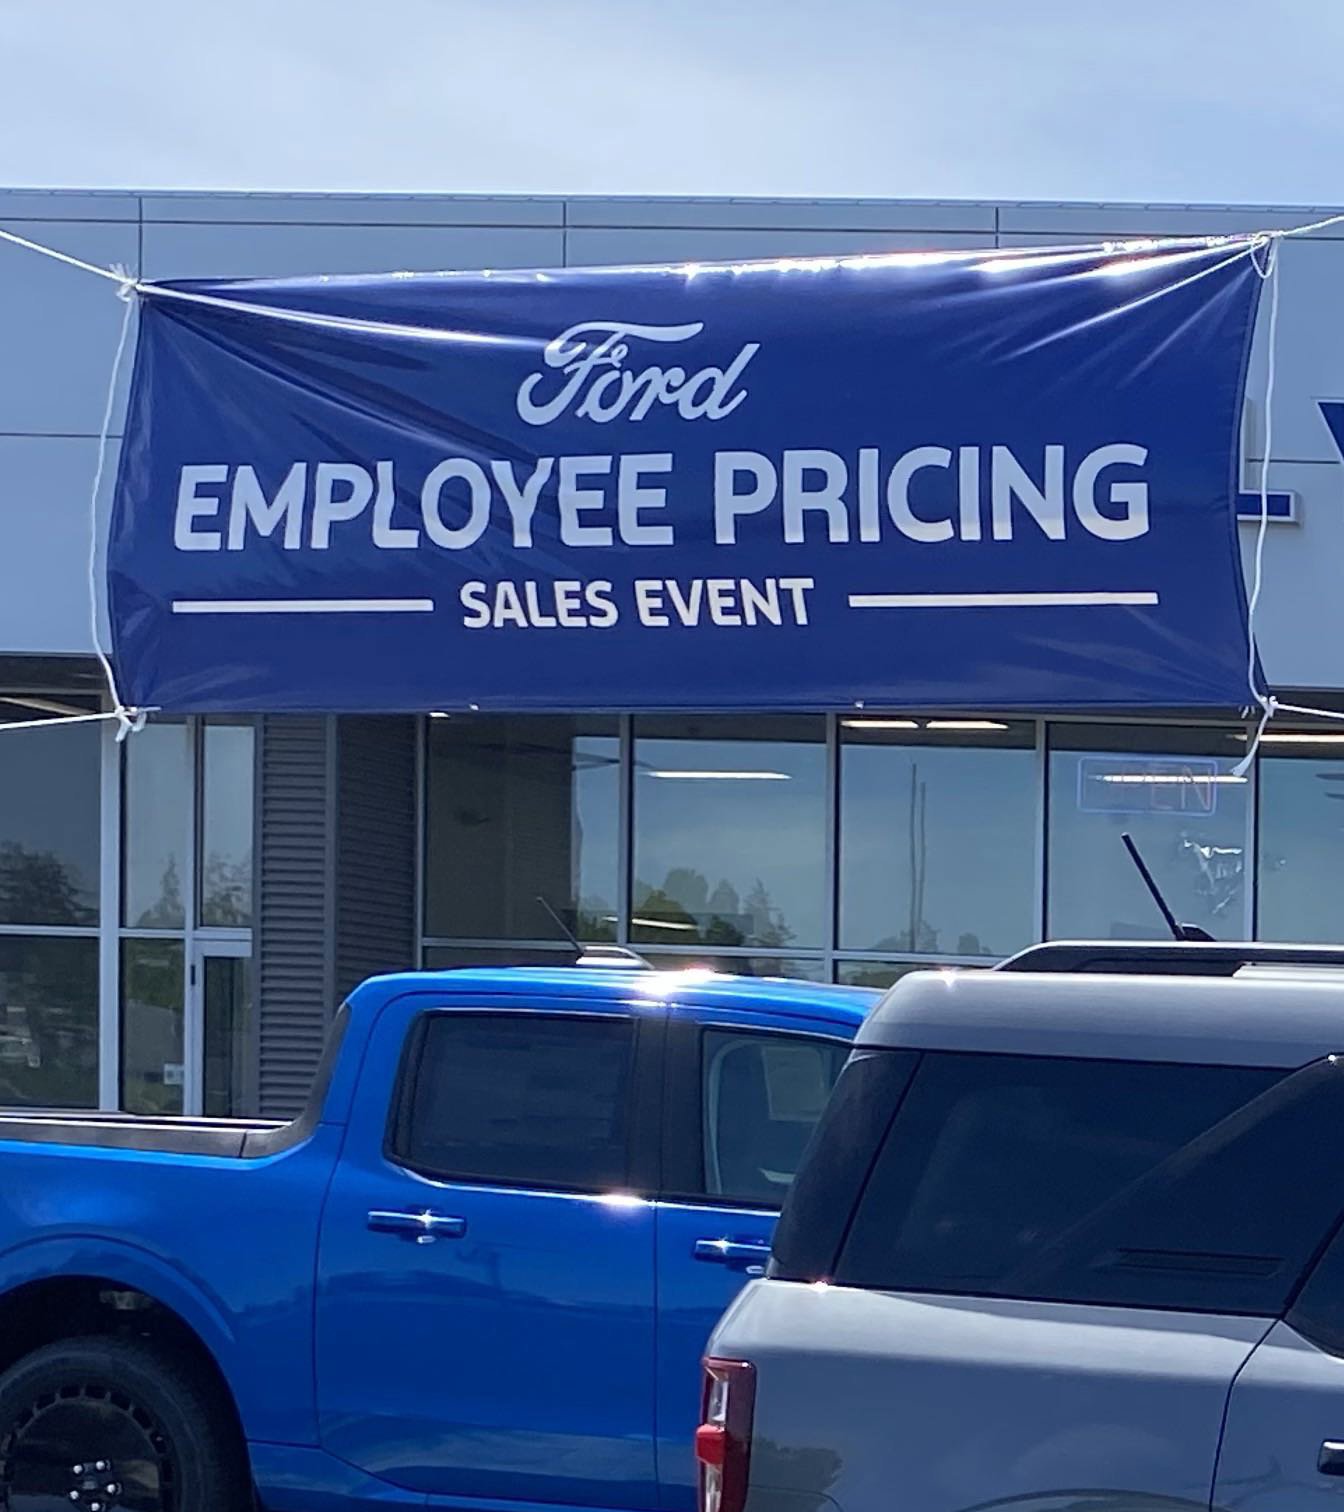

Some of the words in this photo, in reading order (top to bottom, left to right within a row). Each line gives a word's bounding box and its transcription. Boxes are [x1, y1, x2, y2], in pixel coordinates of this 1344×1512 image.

[515, 319, 762, 426] Ford
[173, 453, 675, 552] EMPLOYEE
[713, 442, 1150, 545] PRICING
[459, 579, 620, 630] SALES
[633, 577, 815, 628] EVENT
[1086, 762, 1212, 810] EN
